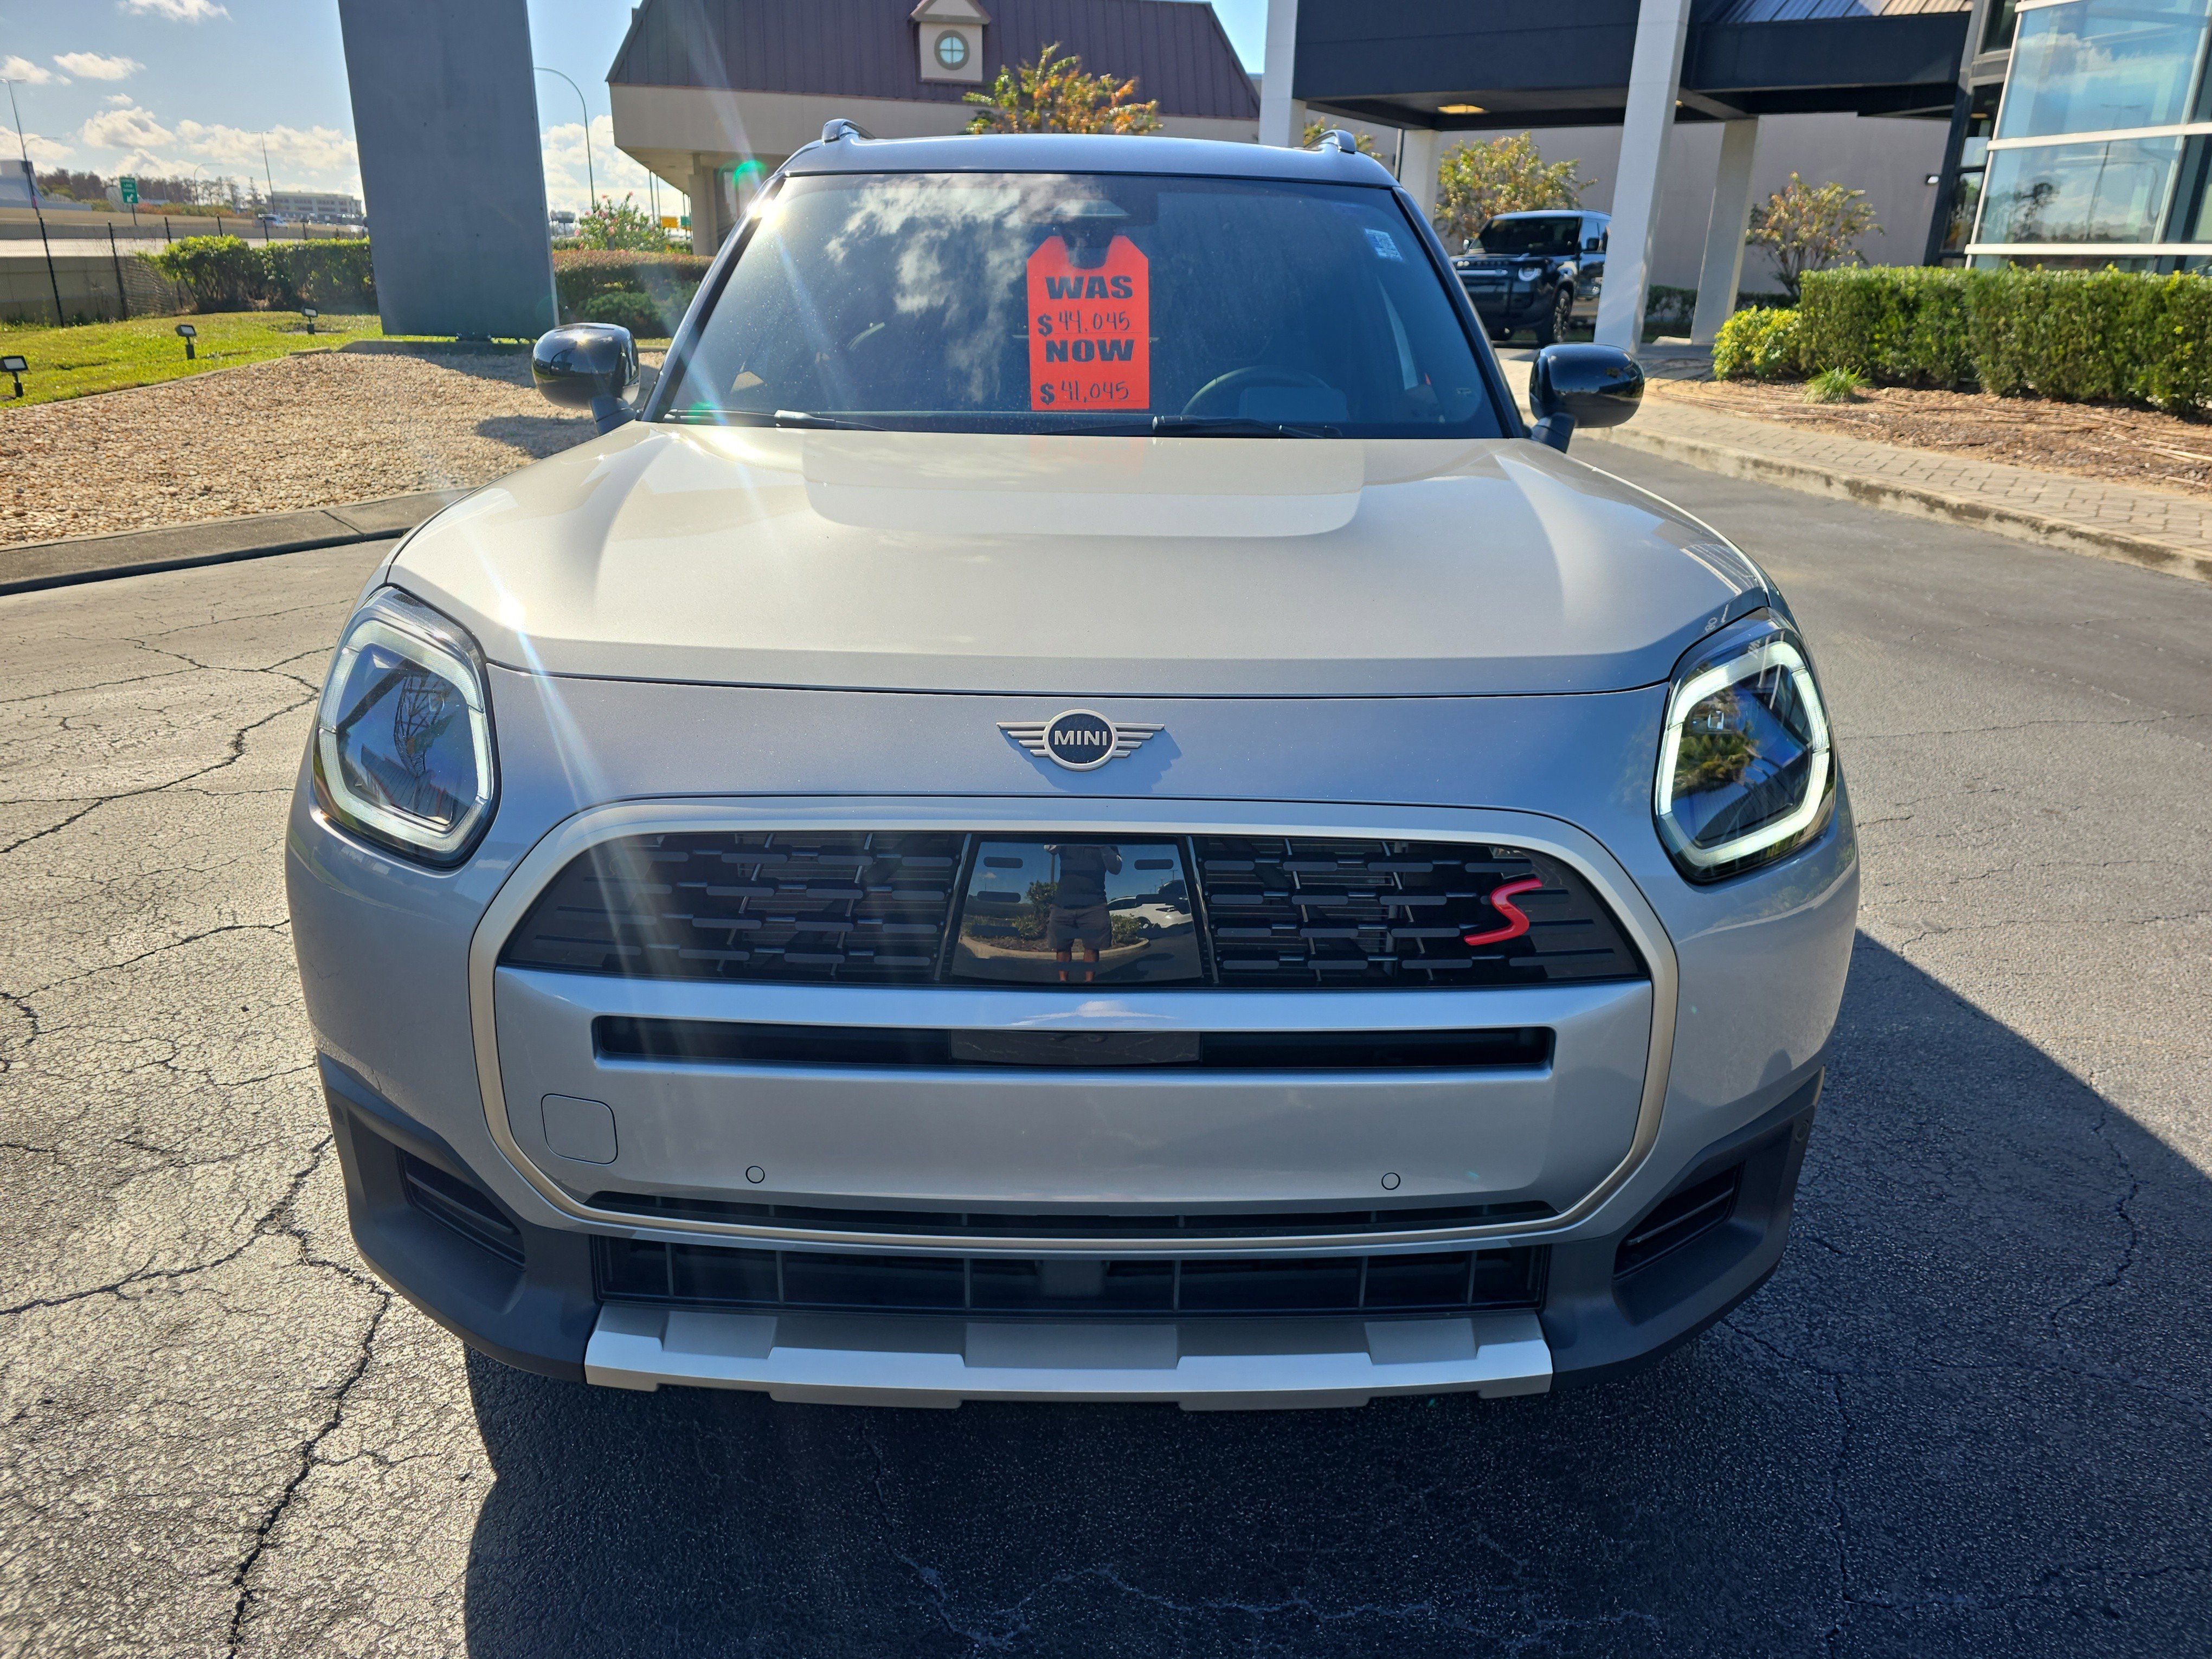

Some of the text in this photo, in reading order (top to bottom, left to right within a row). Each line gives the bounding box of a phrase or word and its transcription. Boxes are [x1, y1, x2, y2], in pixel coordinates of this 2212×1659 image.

[1045, 275, 1133, 299] WAS
[1046, 339, 1135, 362] NOW
[1054, 730, 1107, 746] MINI
[1464, 878, 1542, 946] S
